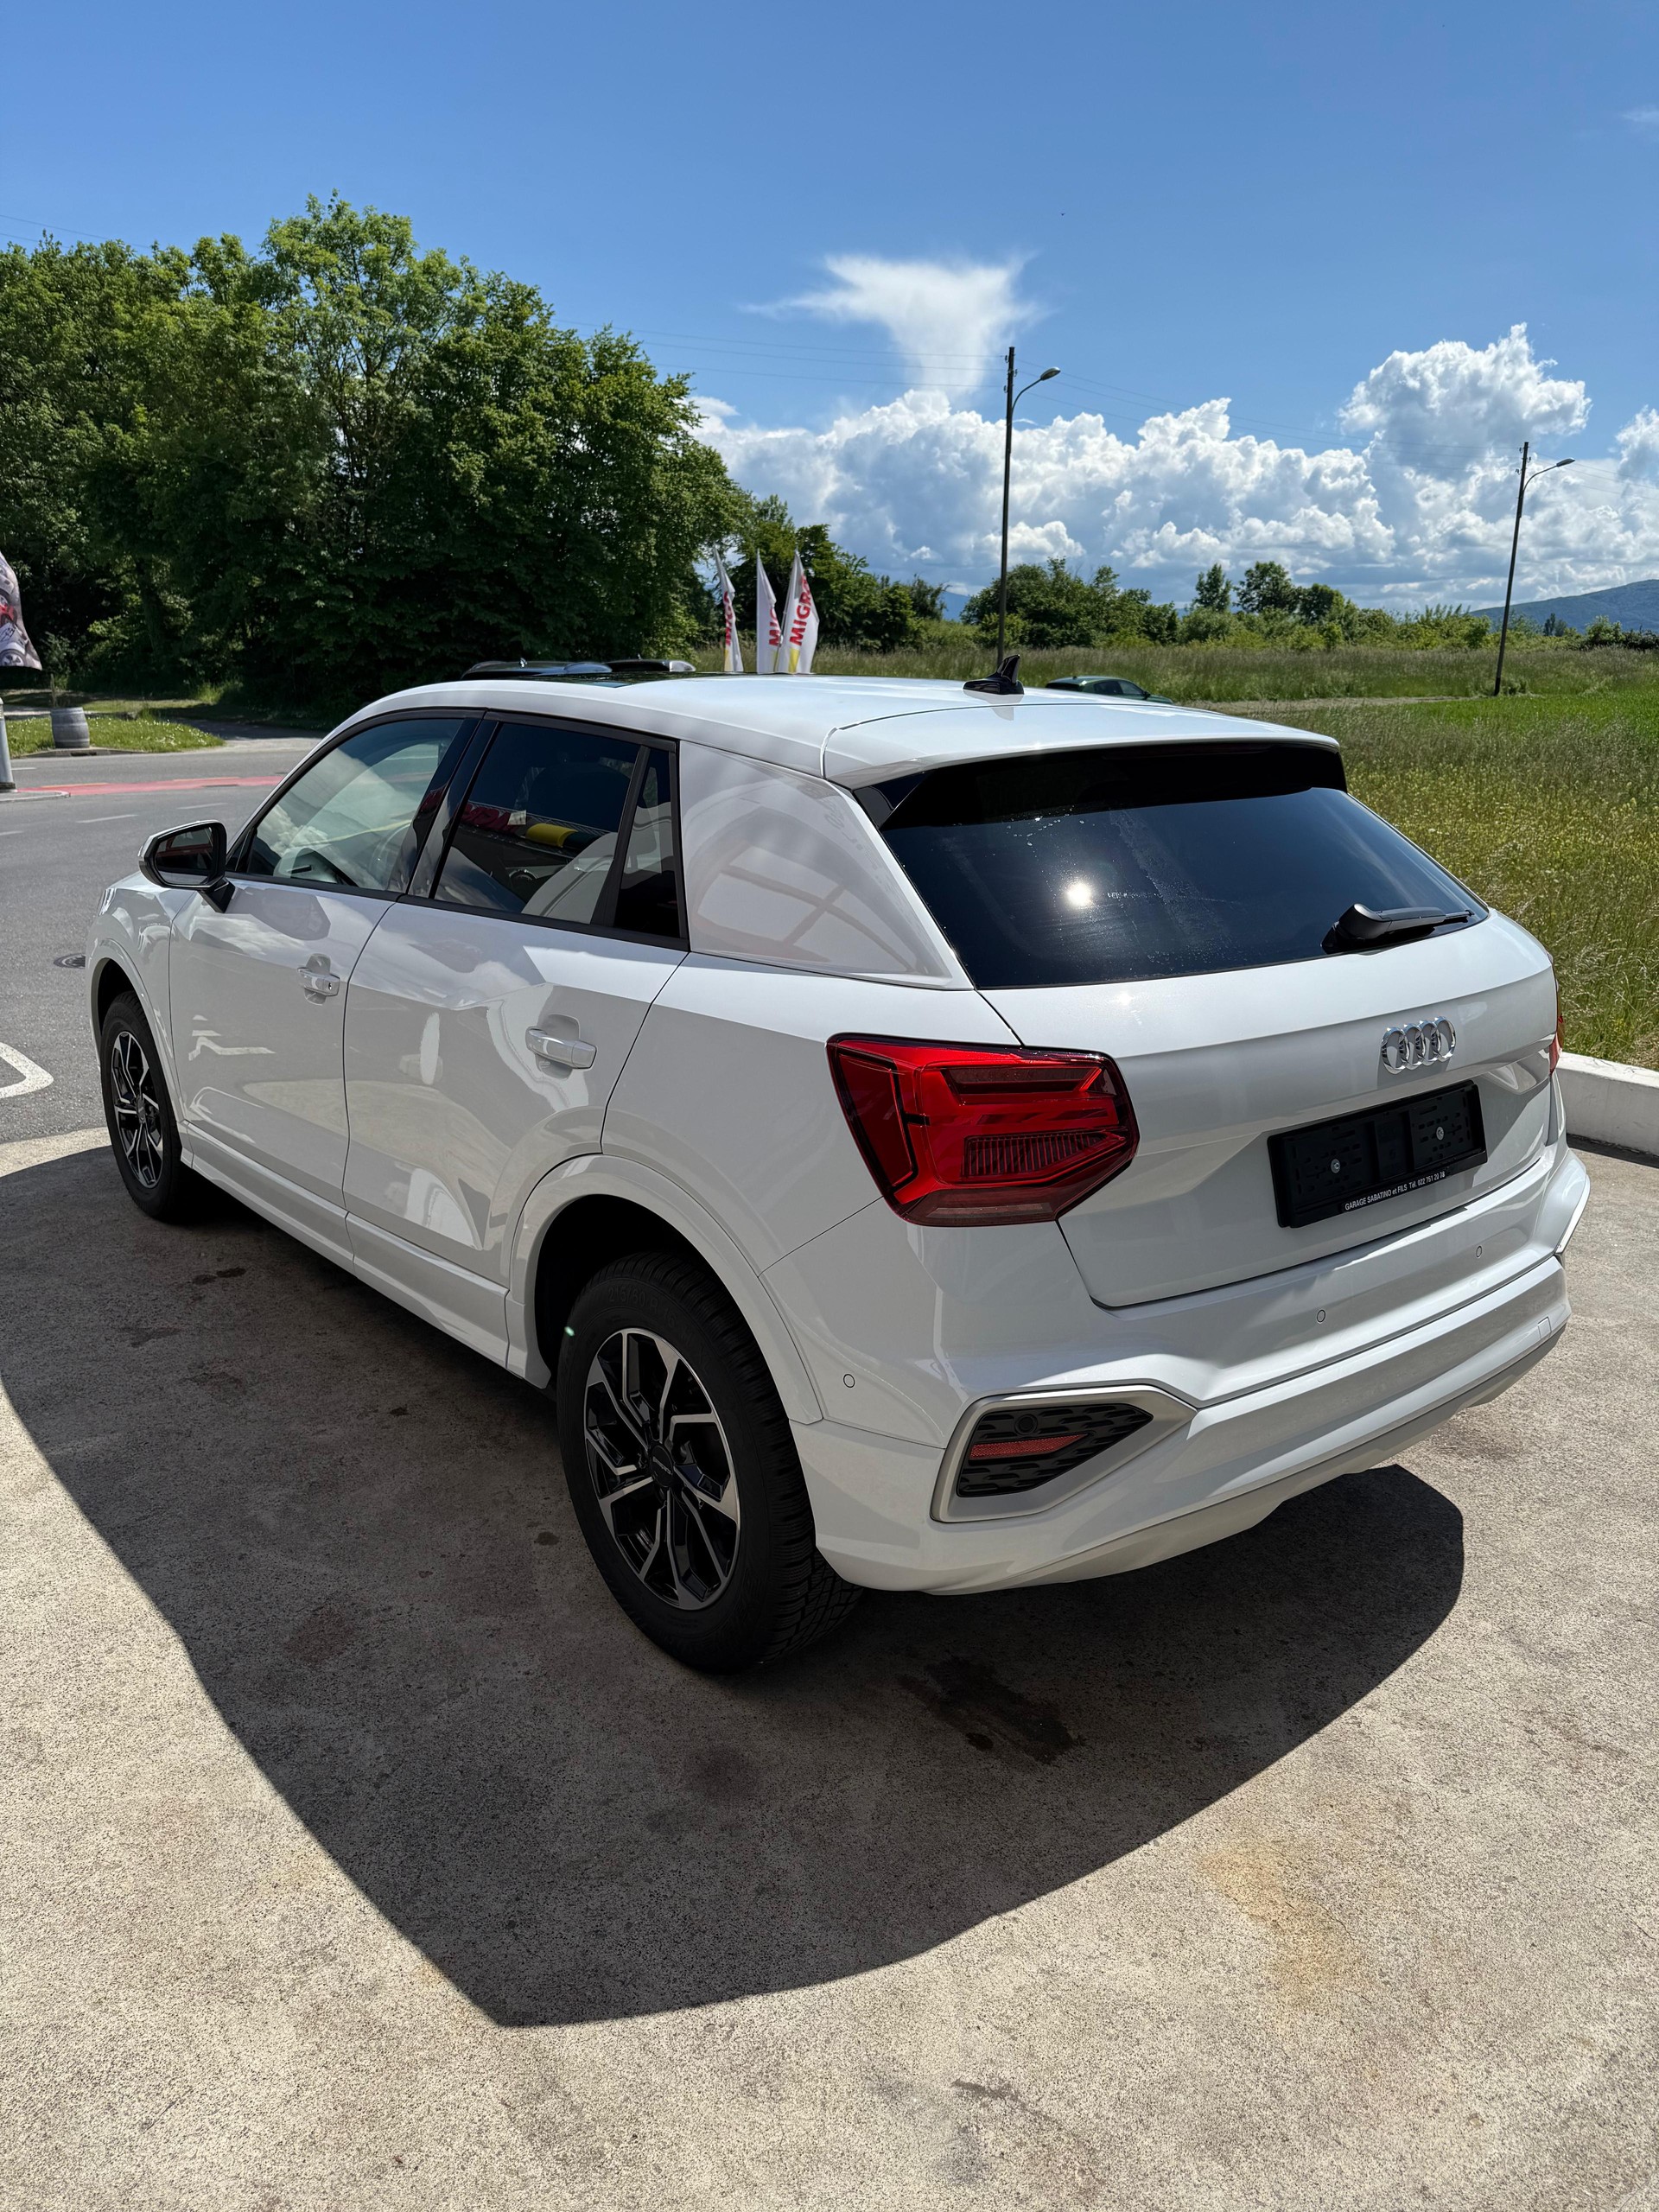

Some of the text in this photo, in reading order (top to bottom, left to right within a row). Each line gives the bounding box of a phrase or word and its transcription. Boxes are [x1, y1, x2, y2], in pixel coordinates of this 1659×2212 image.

[1344, 1197, 1367, 1211] GARAGE
[1367, 1189, 1392, 1203] SABATINO
[1397, 1184, 1408, 1193] FILS
[1417, 1178, 1426, 1186] 022
[607, 1284, 646, 1307] 215/60
